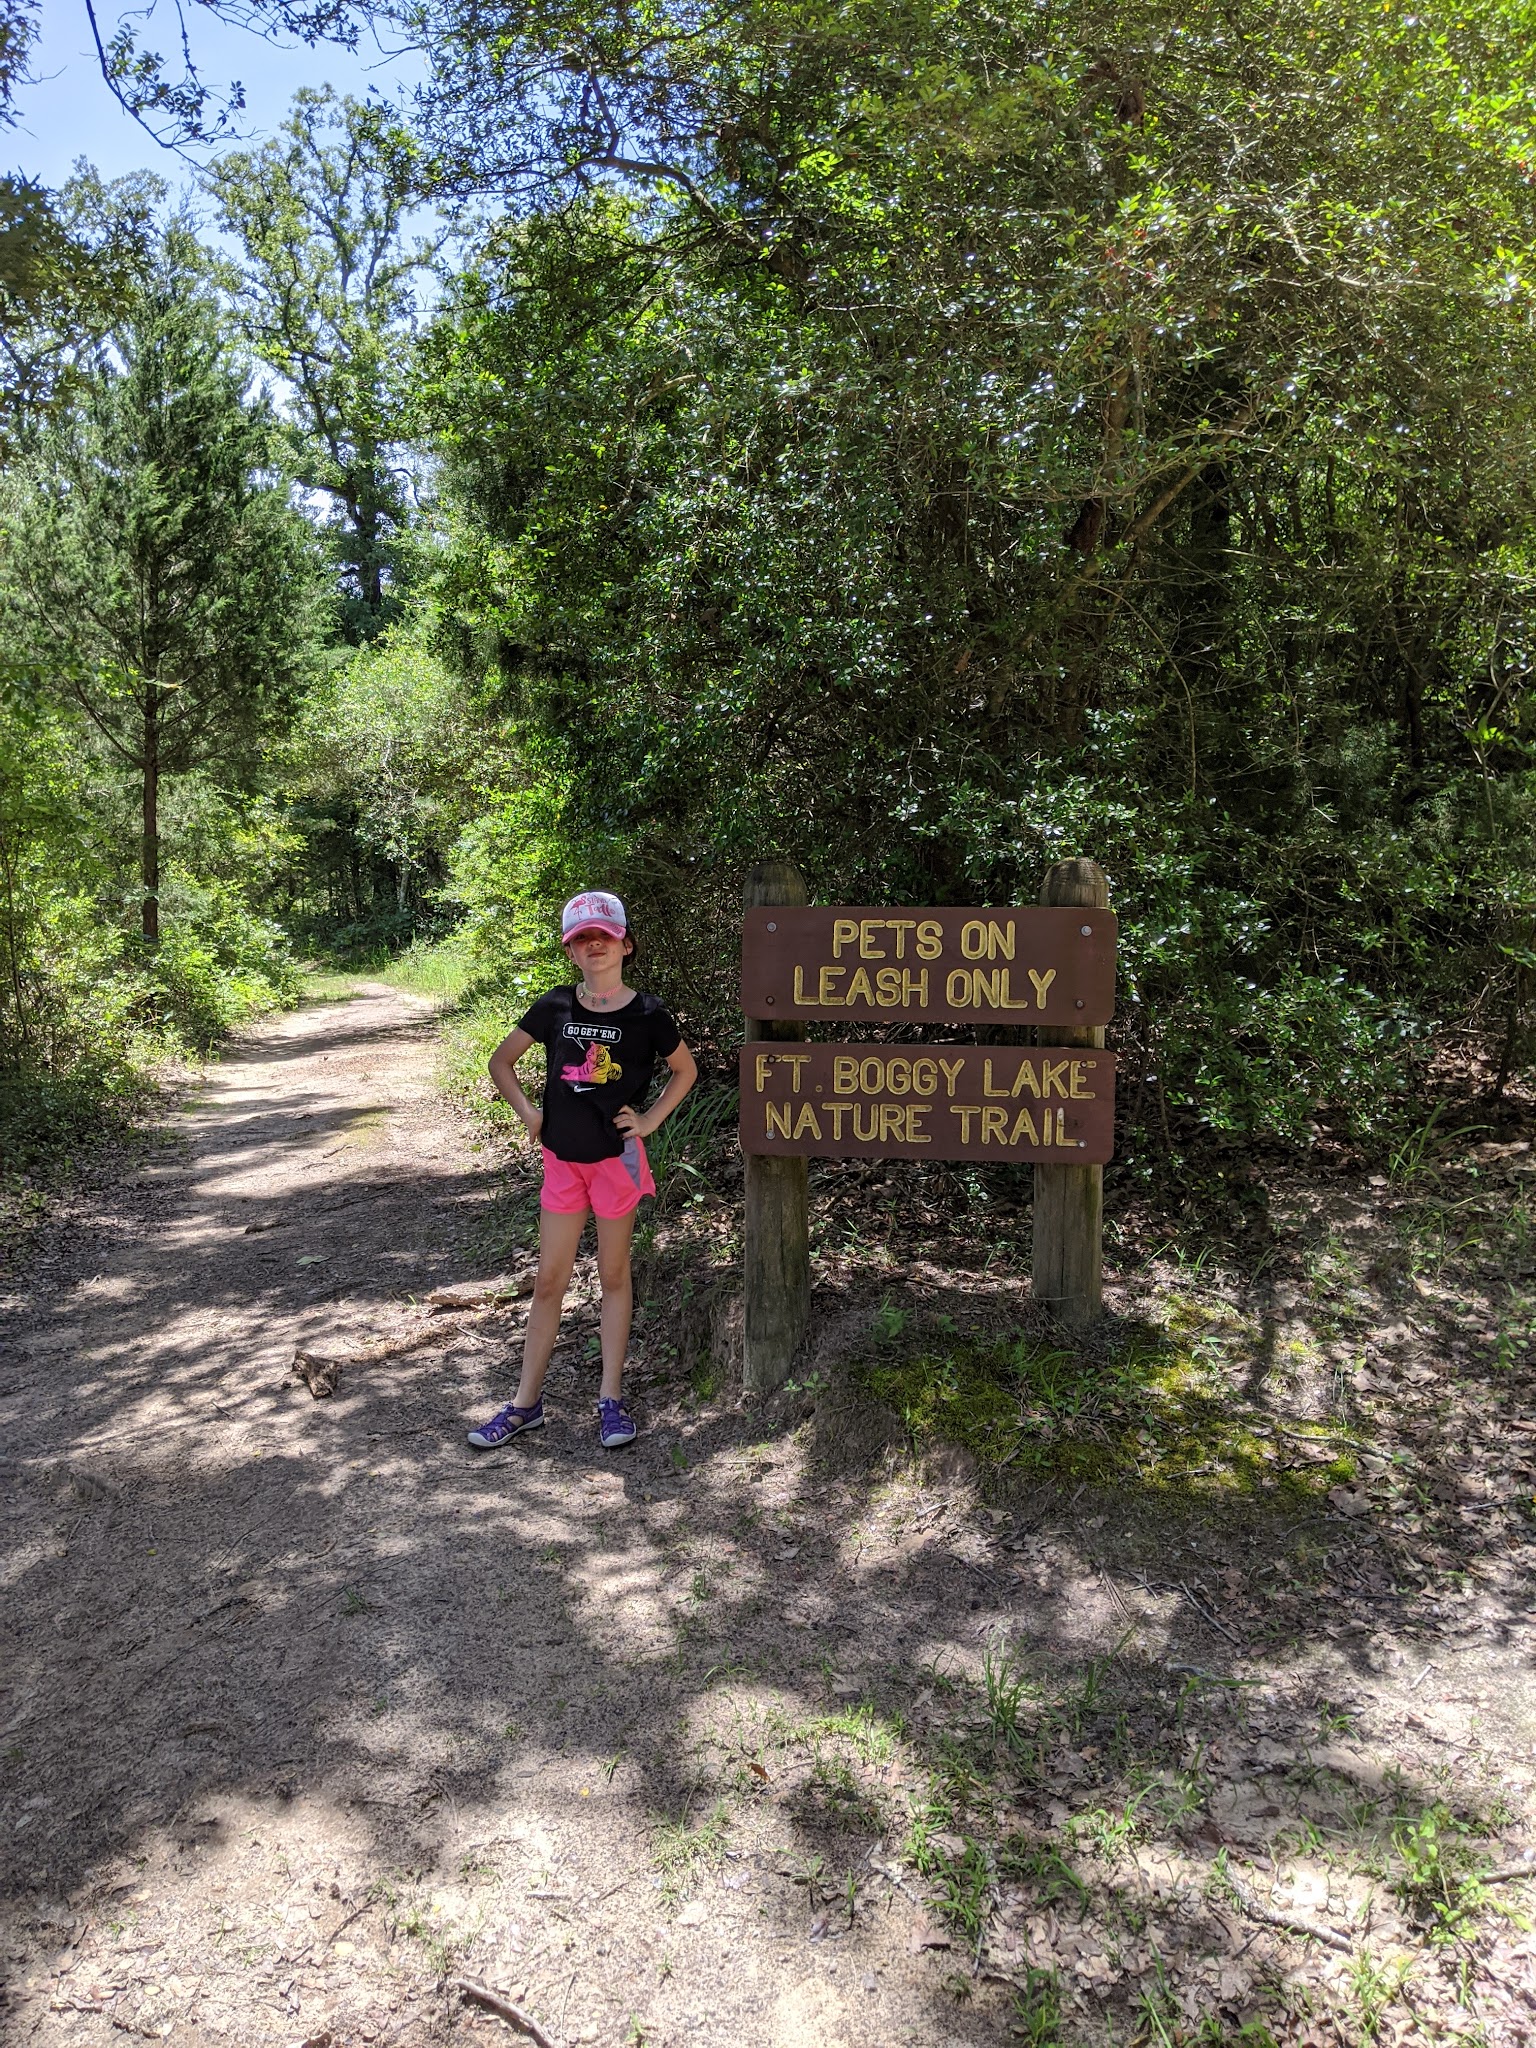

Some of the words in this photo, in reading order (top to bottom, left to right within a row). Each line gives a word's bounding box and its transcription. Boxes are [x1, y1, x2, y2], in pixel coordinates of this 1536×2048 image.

[833, 919, 943, 960] PETS
[961, 920, 1015, 960] ON
[794, 965, 929, 1007] LEASH
[946, 968, 1056, 1009] ONLY
[567, 1026, 579, 1035] GO
[580, 1027, 598, 1037] GET
[600, 1029, 616, 1040] 'EM
[833, 1056, 965, 1097] BOGGY
[984, 1058, 1097, 1099] LAKE
[766, 1101, 932, 1143] NATURE
[950, 1105, 1085, 1147] TRAIL
